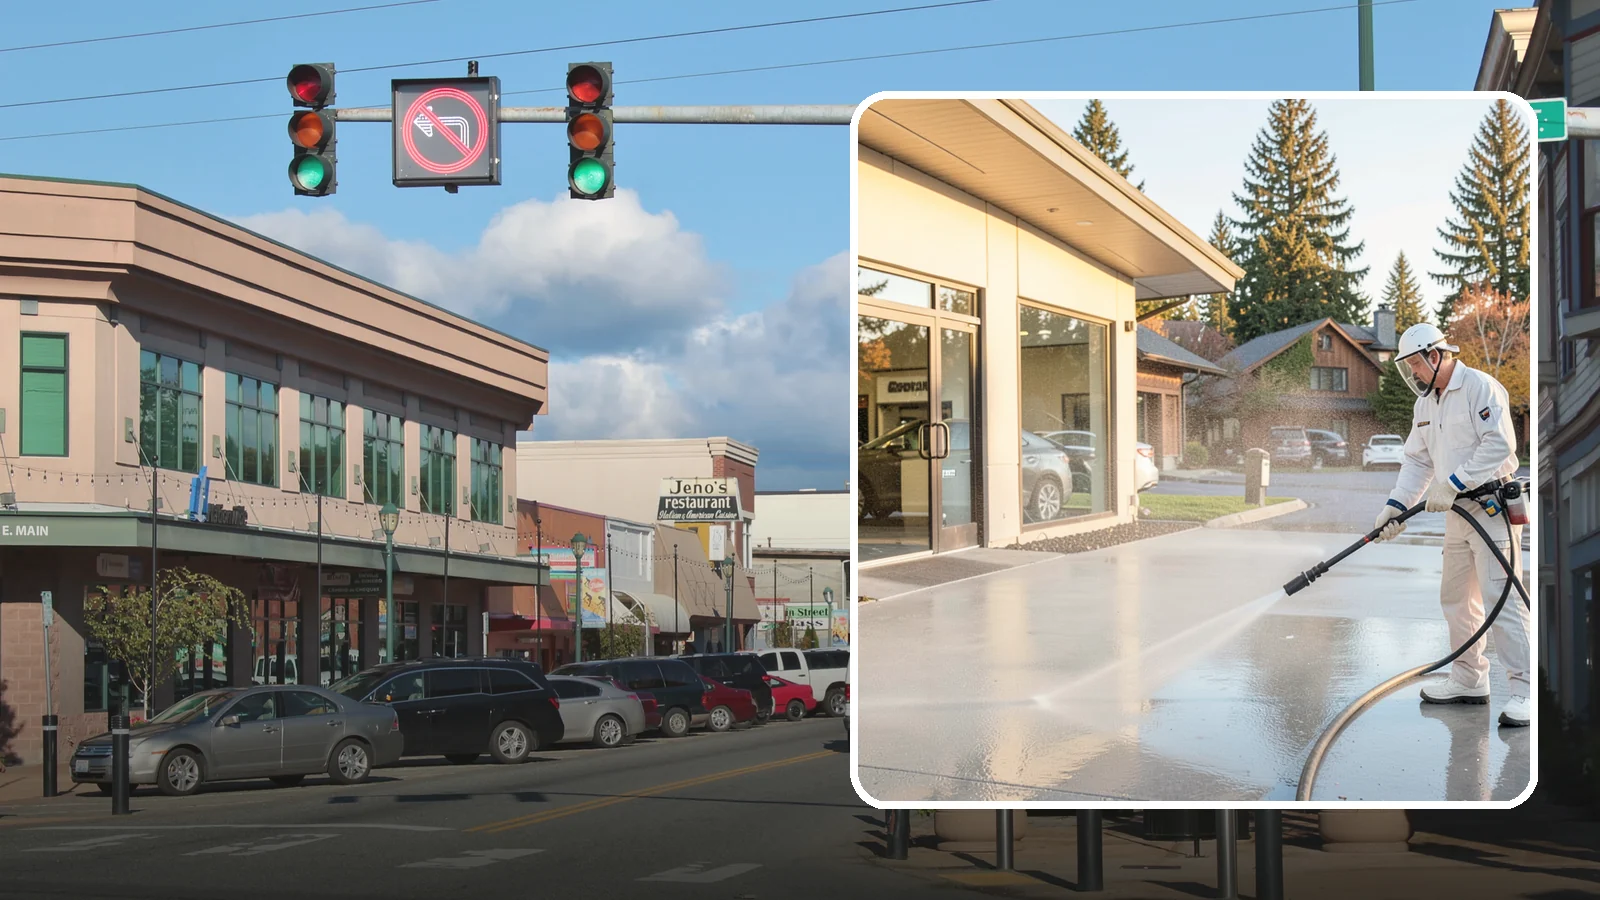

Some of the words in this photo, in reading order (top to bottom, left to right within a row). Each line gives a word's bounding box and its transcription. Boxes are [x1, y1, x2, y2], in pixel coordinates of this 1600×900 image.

[669, 480, 728, 495] Jeno's
[665, 496, 731, 509] restaurant
[658, 510, 681, 519] Italian
[686, 509, 714, 519] American
[715, 509, 738, 519] Cuisine
[2, 525, 13, 536] E.
[15, 525, 49, 536] MAIN
[797, 608, 829, 616] Street
